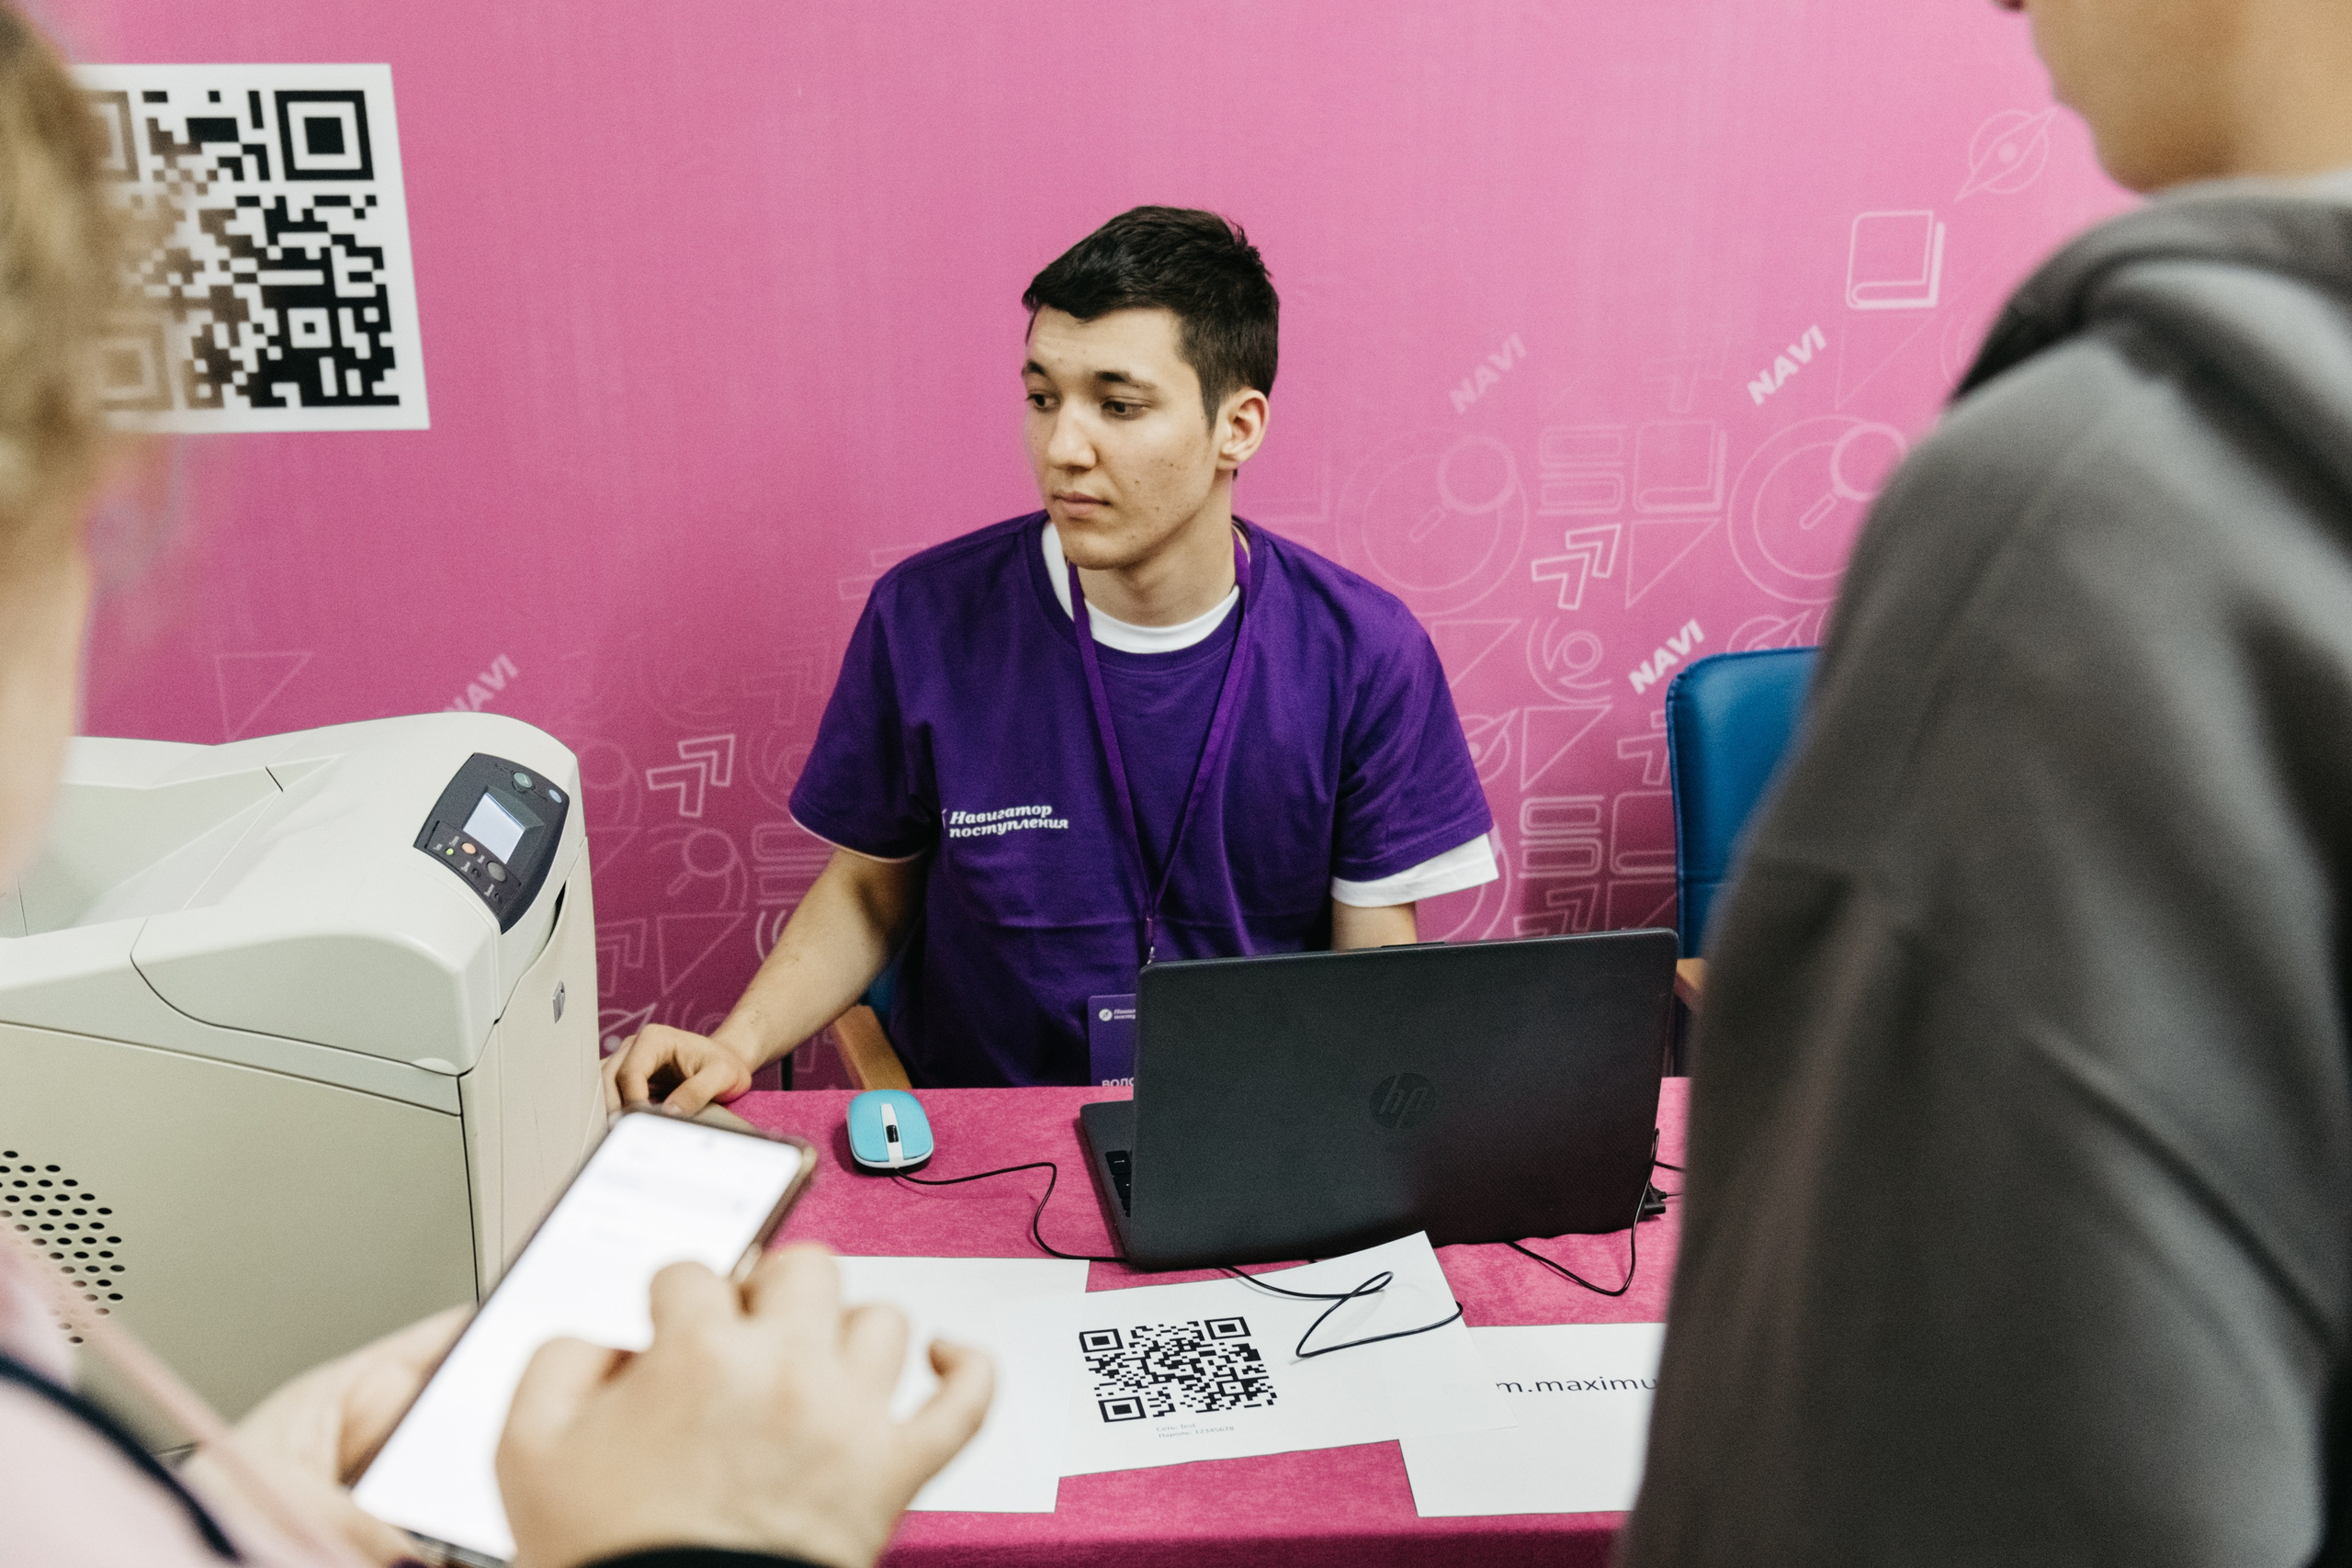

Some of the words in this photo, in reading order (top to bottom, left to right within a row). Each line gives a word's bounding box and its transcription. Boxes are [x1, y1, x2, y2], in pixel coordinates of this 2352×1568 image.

[1450, 333, 1525, 414] NAVI
[1747, 325, 1826, 405] NAVI
[1629, 619, 1704, 694] NAVI
[949, 805, 1053, 825] Навигатор
[949, 818, 1069, 838] поступления
